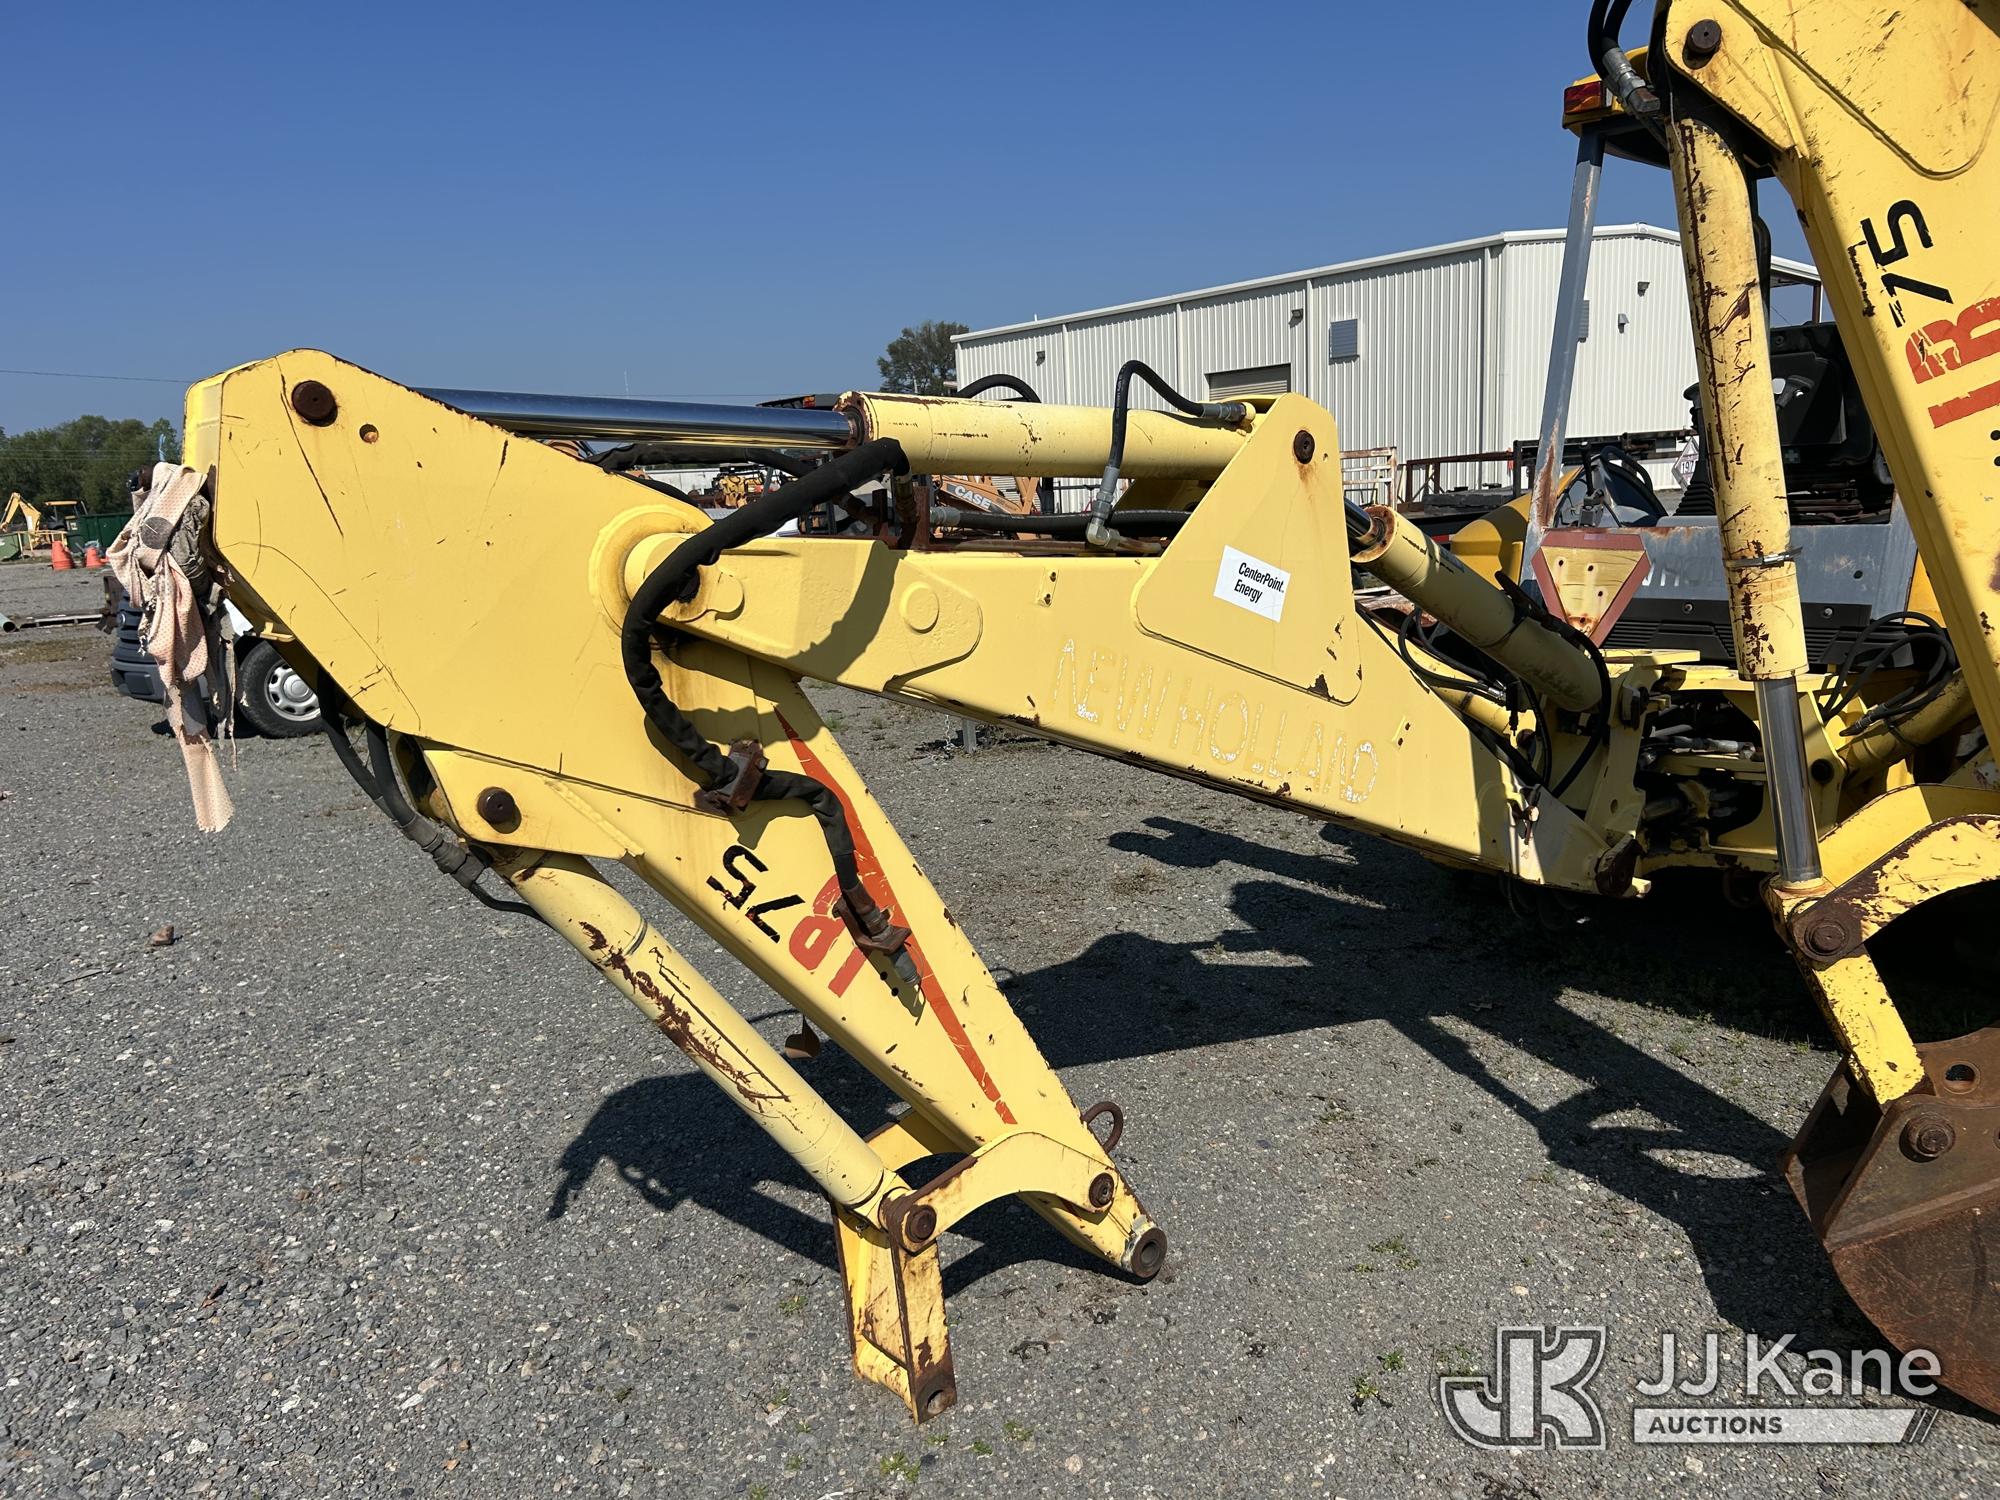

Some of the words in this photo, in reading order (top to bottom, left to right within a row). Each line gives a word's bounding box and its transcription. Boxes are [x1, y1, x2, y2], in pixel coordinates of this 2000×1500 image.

[1681, 461, 1696, 473] 197
[954, 485, 992, 510] CASE
[1234, 579, 1263, 604] Energy
